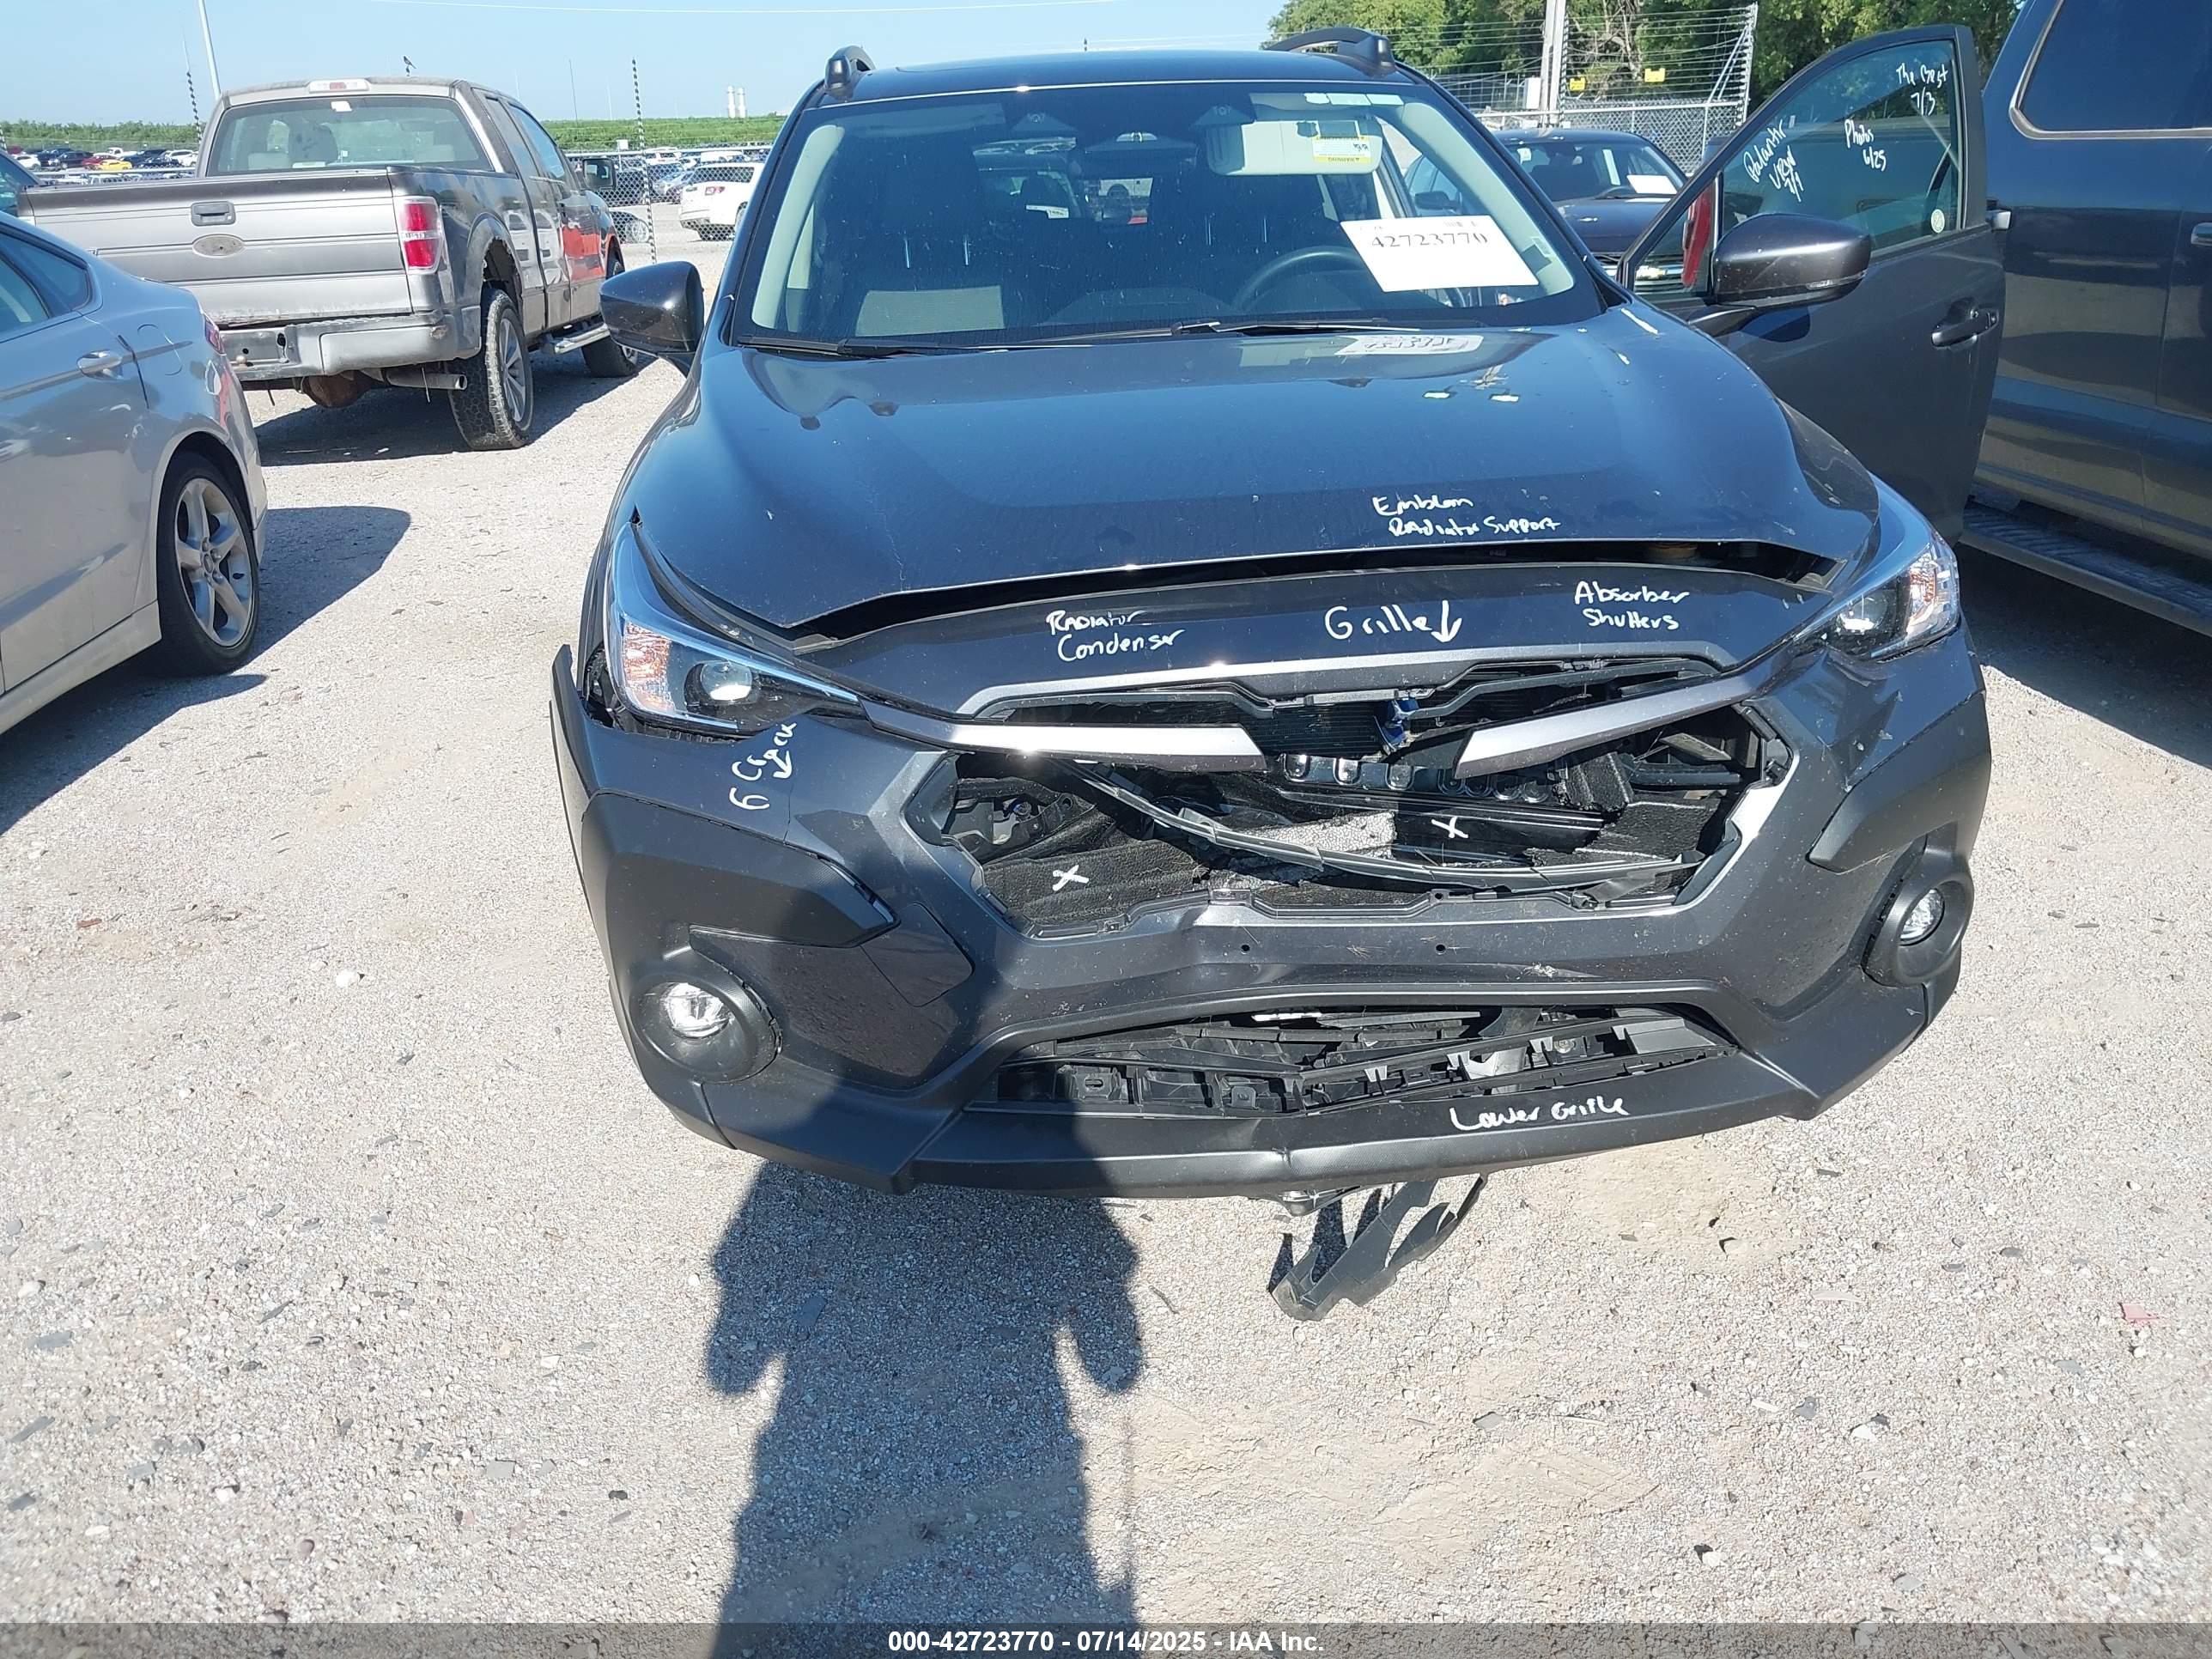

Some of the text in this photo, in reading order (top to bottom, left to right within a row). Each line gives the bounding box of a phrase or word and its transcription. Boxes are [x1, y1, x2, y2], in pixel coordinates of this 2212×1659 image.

[1896, 62, 1916, 86] The
[1844, 118, 1875, 149] Photos
[1371, 232, 1488, 248] 42723770
[1574, 580, 1691, 605] Absorber
[1325, 605, 1432, 641] Grille
[1582, 609, 1680, 631] Shutters
[1449, 1106, 1540, 1131] Lower
